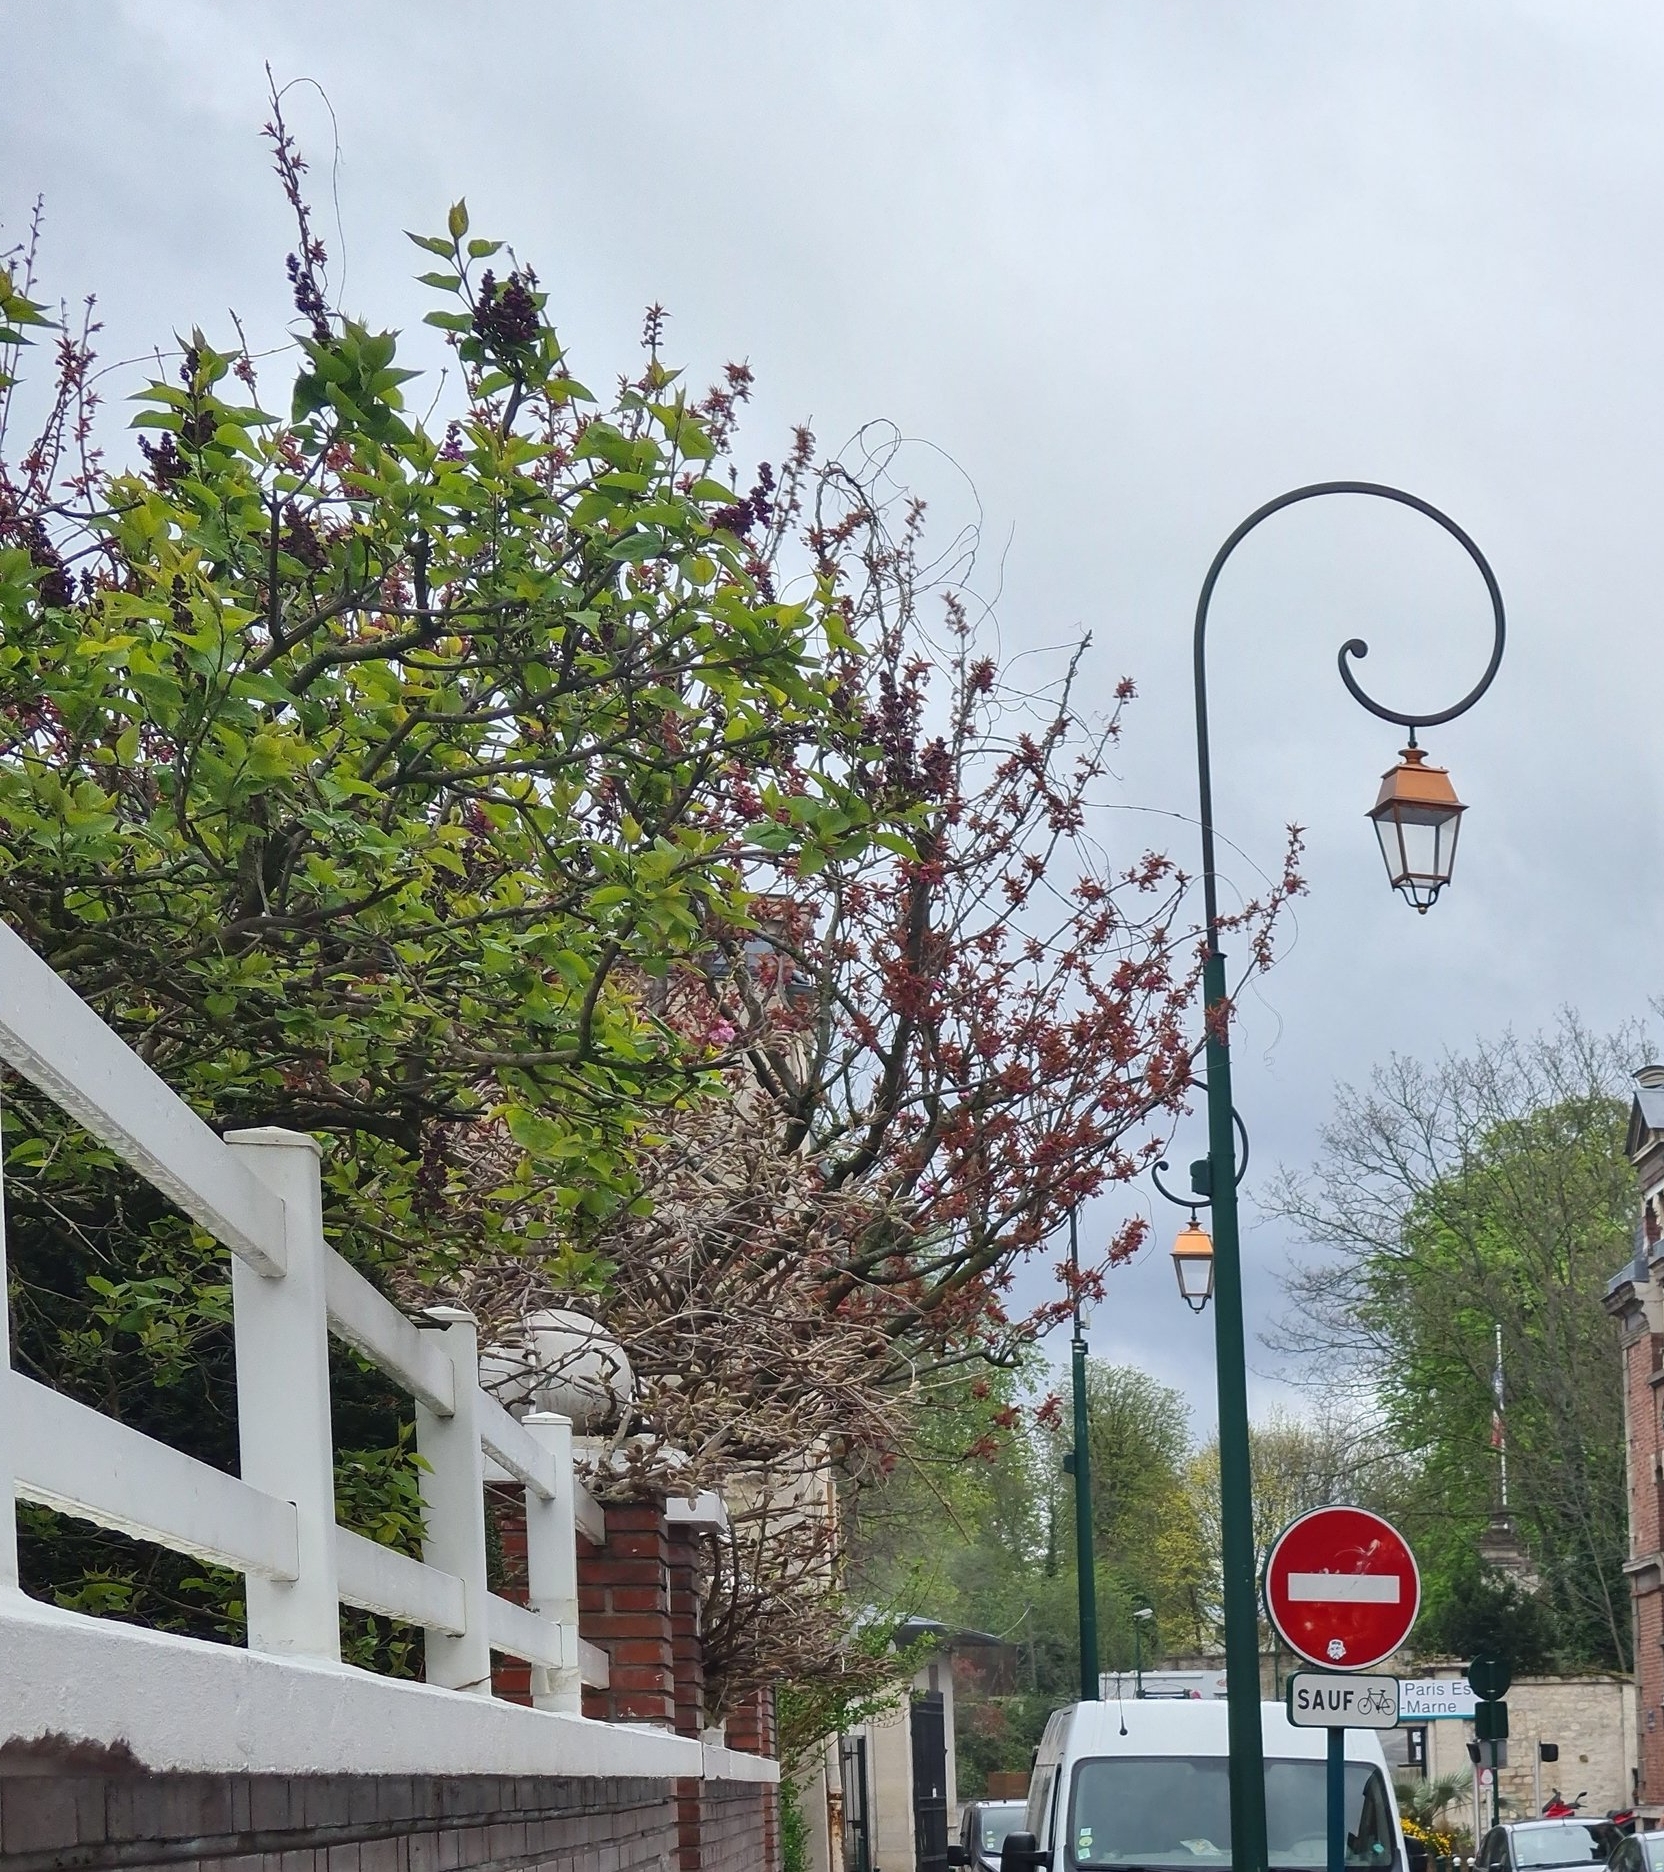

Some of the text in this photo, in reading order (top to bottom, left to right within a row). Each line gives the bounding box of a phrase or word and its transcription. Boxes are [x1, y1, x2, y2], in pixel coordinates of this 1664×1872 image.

[1404, 1681, 1445, 1697] Paris
[1297, 1688, 1354, 1711] SAUF
[1400, 1700, 1457, 1714] -Marne
